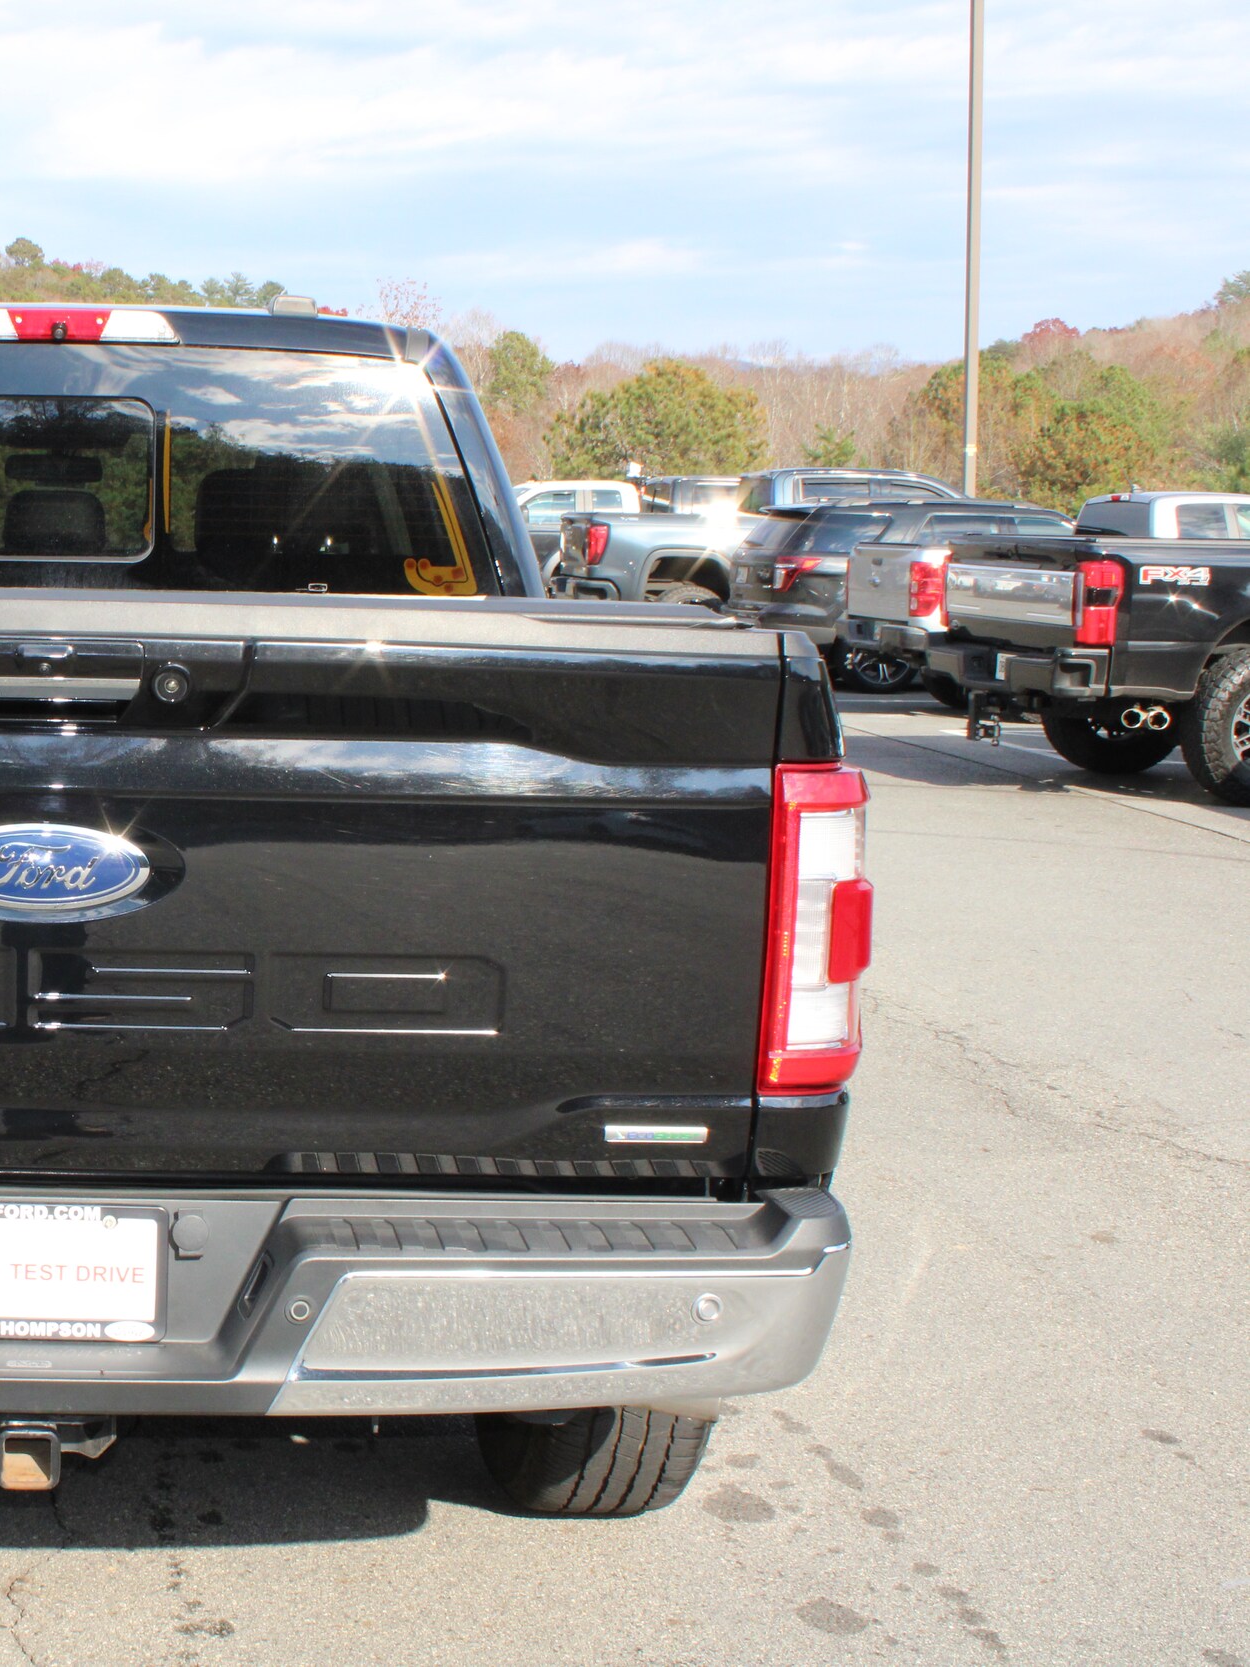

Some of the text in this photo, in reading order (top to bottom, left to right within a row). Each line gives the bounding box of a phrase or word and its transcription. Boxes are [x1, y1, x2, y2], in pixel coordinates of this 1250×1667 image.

[1139, 566, 1211, 585] FX4
[10, 1264, 145, 1283] TEST DRIVE
